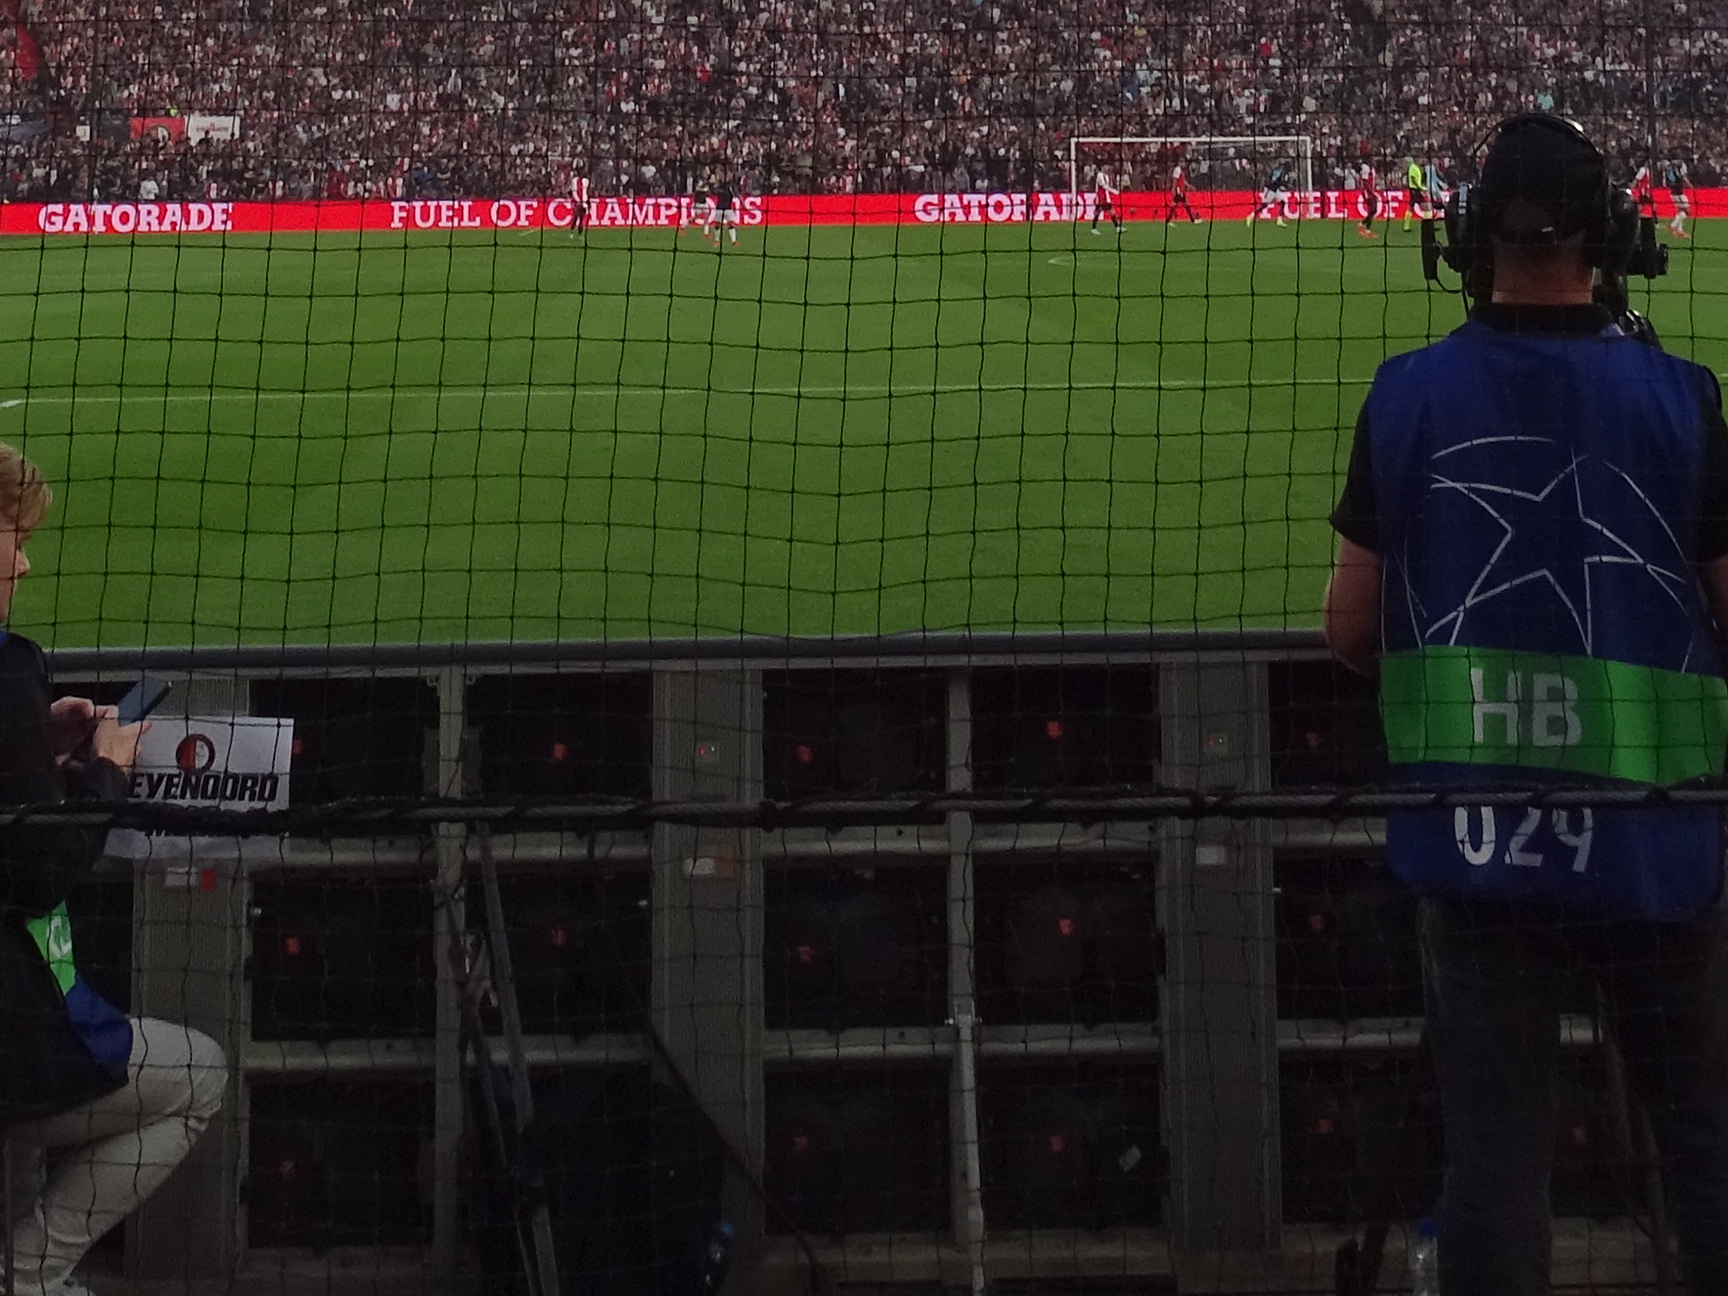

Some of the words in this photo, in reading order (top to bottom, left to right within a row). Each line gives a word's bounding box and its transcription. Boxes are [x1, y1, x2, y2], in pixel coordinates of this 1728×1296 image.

[38, 202, 233, 233] GATORADE
[390, 200, 480, 229] FUEL
[490, 199, 538, 227] OF
[914, 193, 1104, 222] GATORADE
[1259, 190, 1348, 219] FUEL
[1358, 190, 1403, 219] OF
[1470, 667, 1583, 747] HB
[130, 772, 279, 803] EYENOORD
[1453, 805, 1594, 873] 029
